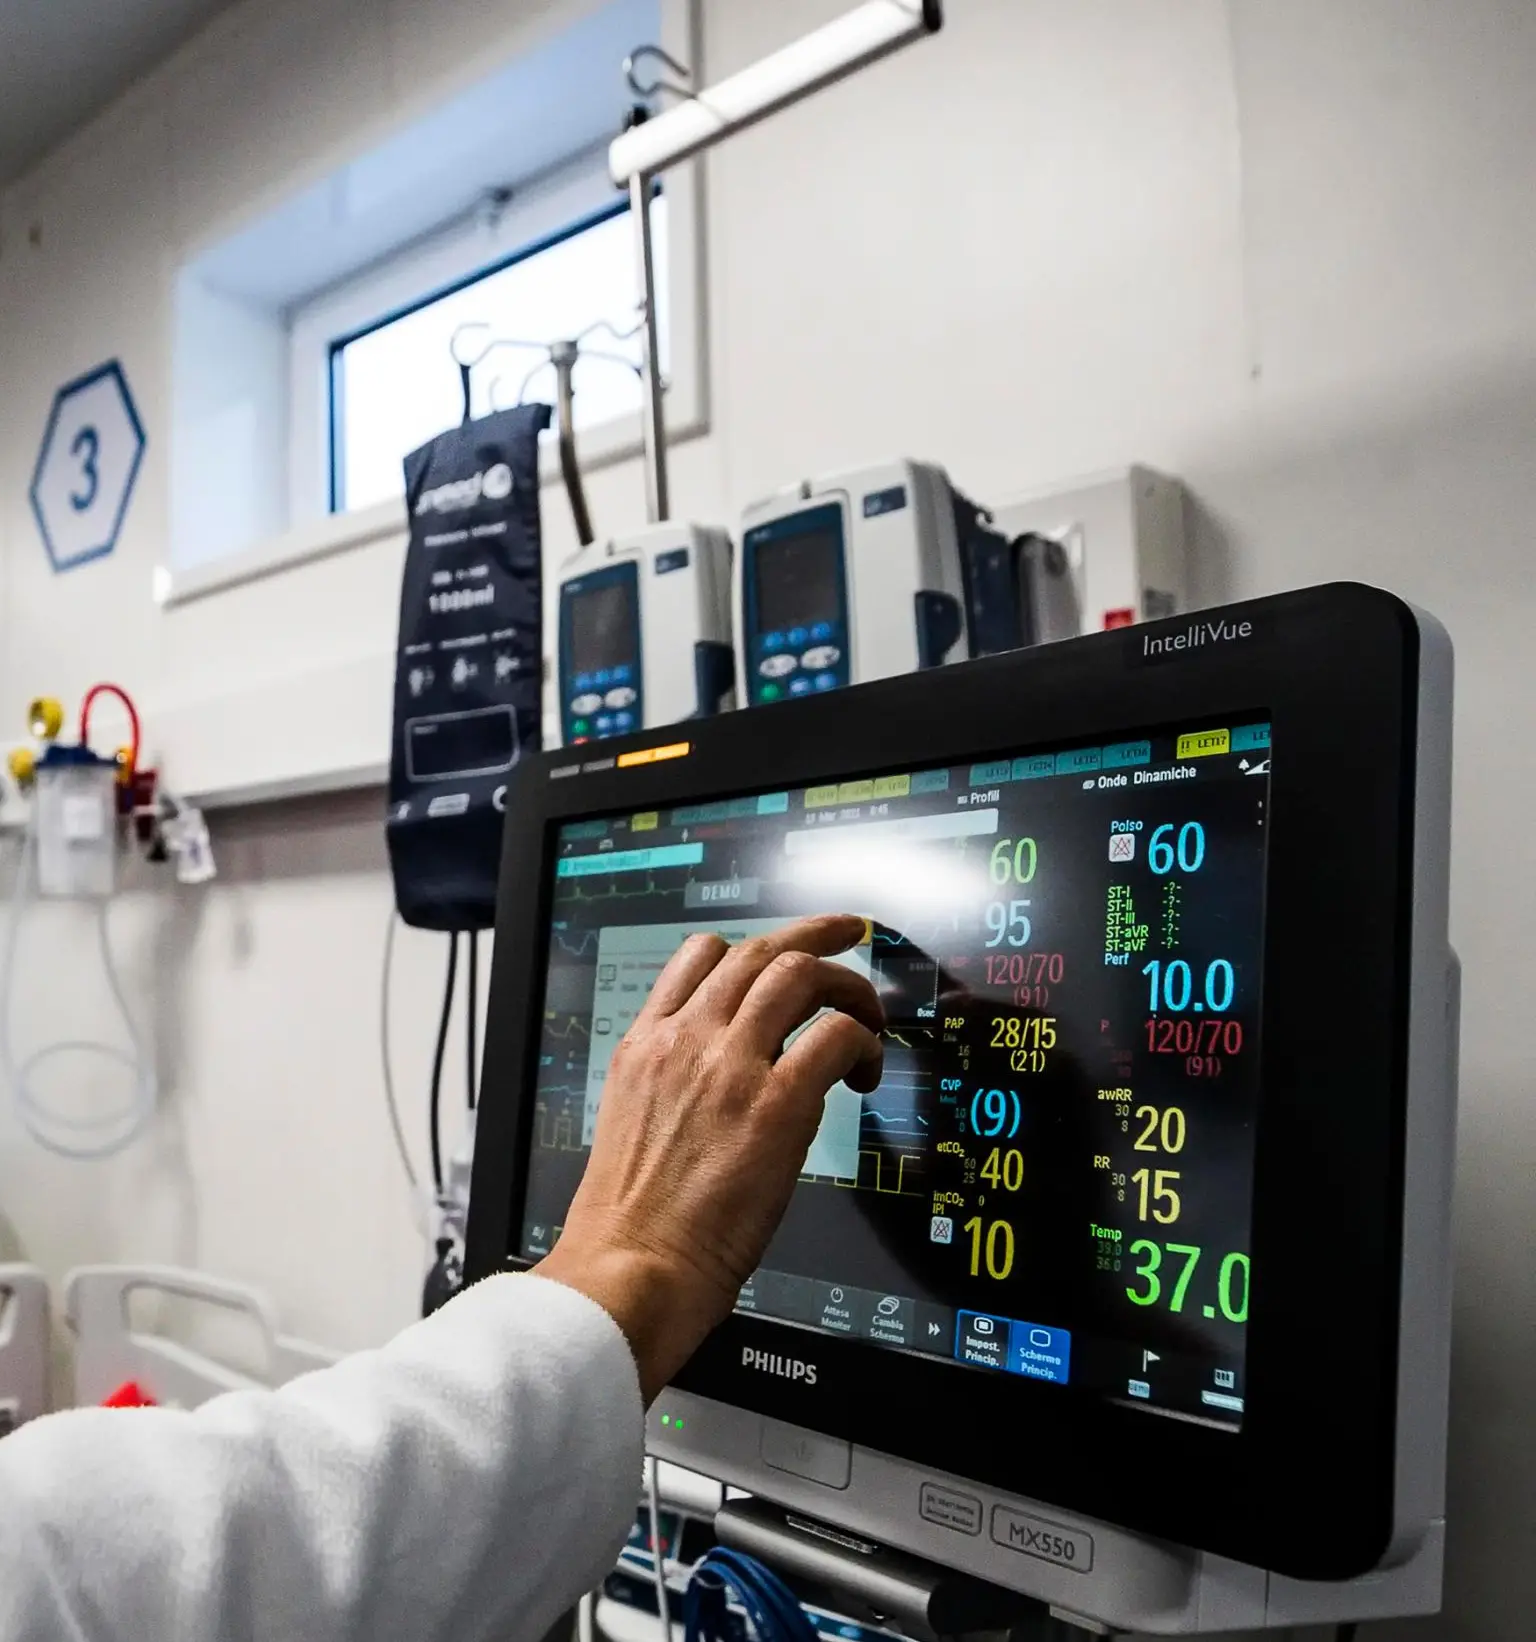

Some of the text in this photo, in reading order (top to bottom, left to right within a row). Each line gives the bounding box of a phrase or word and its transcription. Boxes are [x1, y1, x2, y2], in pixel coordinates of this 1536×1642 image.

[69, 427, 100, 511] 3
[1144, 620, 1252, 656] IntelliVue
[1098, 765, 1197, 789] Onde Dinamiche
[970, 789, 1000, 805] Profili
[1111, 819, 1143, 833] Polso
[1148, 821, 1206, 875] 60
[989, 837, 1037, 885] 60
[702, 884, 741, 901] DEMO
[985, 900, 1032, 948] 95
[1106, 925, 1149, 938] ST-aVR
[1105, 938, 1146, 952] ST-aVF
[984, 953, 1064, 985] 120/70
[1104, 952, 1130, 965] Perf
[1014, 986, 1049, 1008] (91)
[1142, 958, 1234, 1012] 10.0
[944, 1017, 1056, 1049] PAP 28/15
[1145, 1019, 1242, 1055] 120/70
[1011, 1049, 1045, 1073] (21)
[1186, 1055, 1221, 1077] (91)
[940, 1078, 962, 1091] CVP
[1097, 1088, 1132, 1101] awRR
[970, 1088, 1021, 1138] (9)
[1115, 1104, 1130, 1117] 30
[1134, 1105, 1186, 1153] 20
[980, 1147, 1024, 1191] 40
[1093, 1155, 1111, 1169] RR
[1112, 1173, 1126, 1186] 30
[1131, 1168, 1181, 1224] 15
[1090, 1223, 1122, 1241] Temp
[964, 1216, 1014, 1280] 10
[1126, 1239, 1251, 1322] 37.0
[966, 1336, 1000, 1352] Impost.
[1020, 1347, 1062, 1365] Schermo
[741, 1347, 817, 1385] PHILIPS
[965, 1349, 999, 1366] Princip.
[1021, 1362, 1057, 1380] Princip.
[1010, 1522, 1075, 1561] MX550
